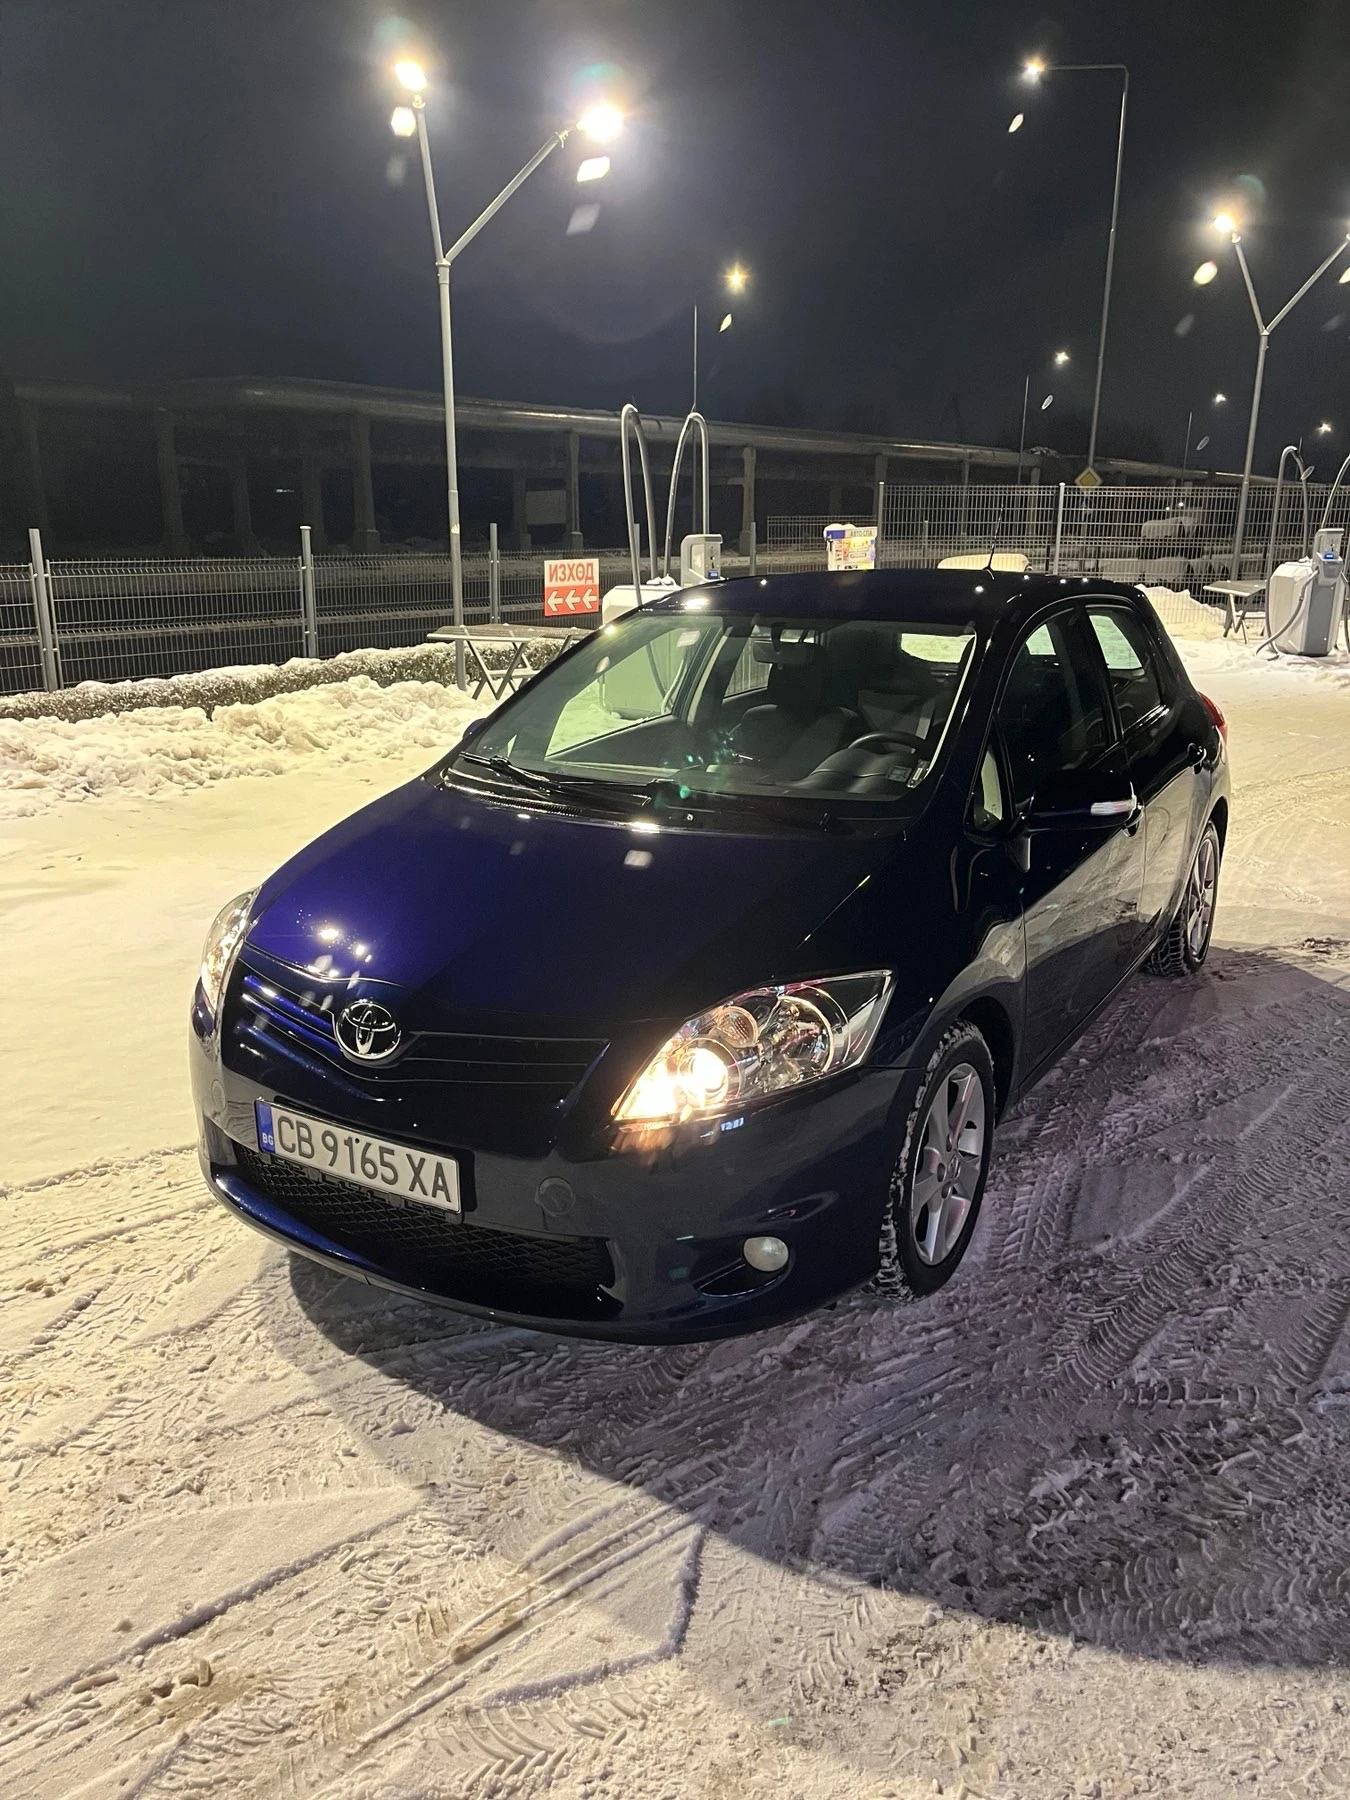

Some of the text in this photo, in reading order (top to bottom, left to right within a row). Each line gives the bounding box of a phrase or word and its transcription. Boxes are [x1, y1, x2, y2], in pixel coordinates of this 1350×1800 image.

[549, 562, 595, 584] ИЗХОД
[262, 1132, 274, 1146] BG
[277, 1115, 452, 1203] CB 9165 XA
